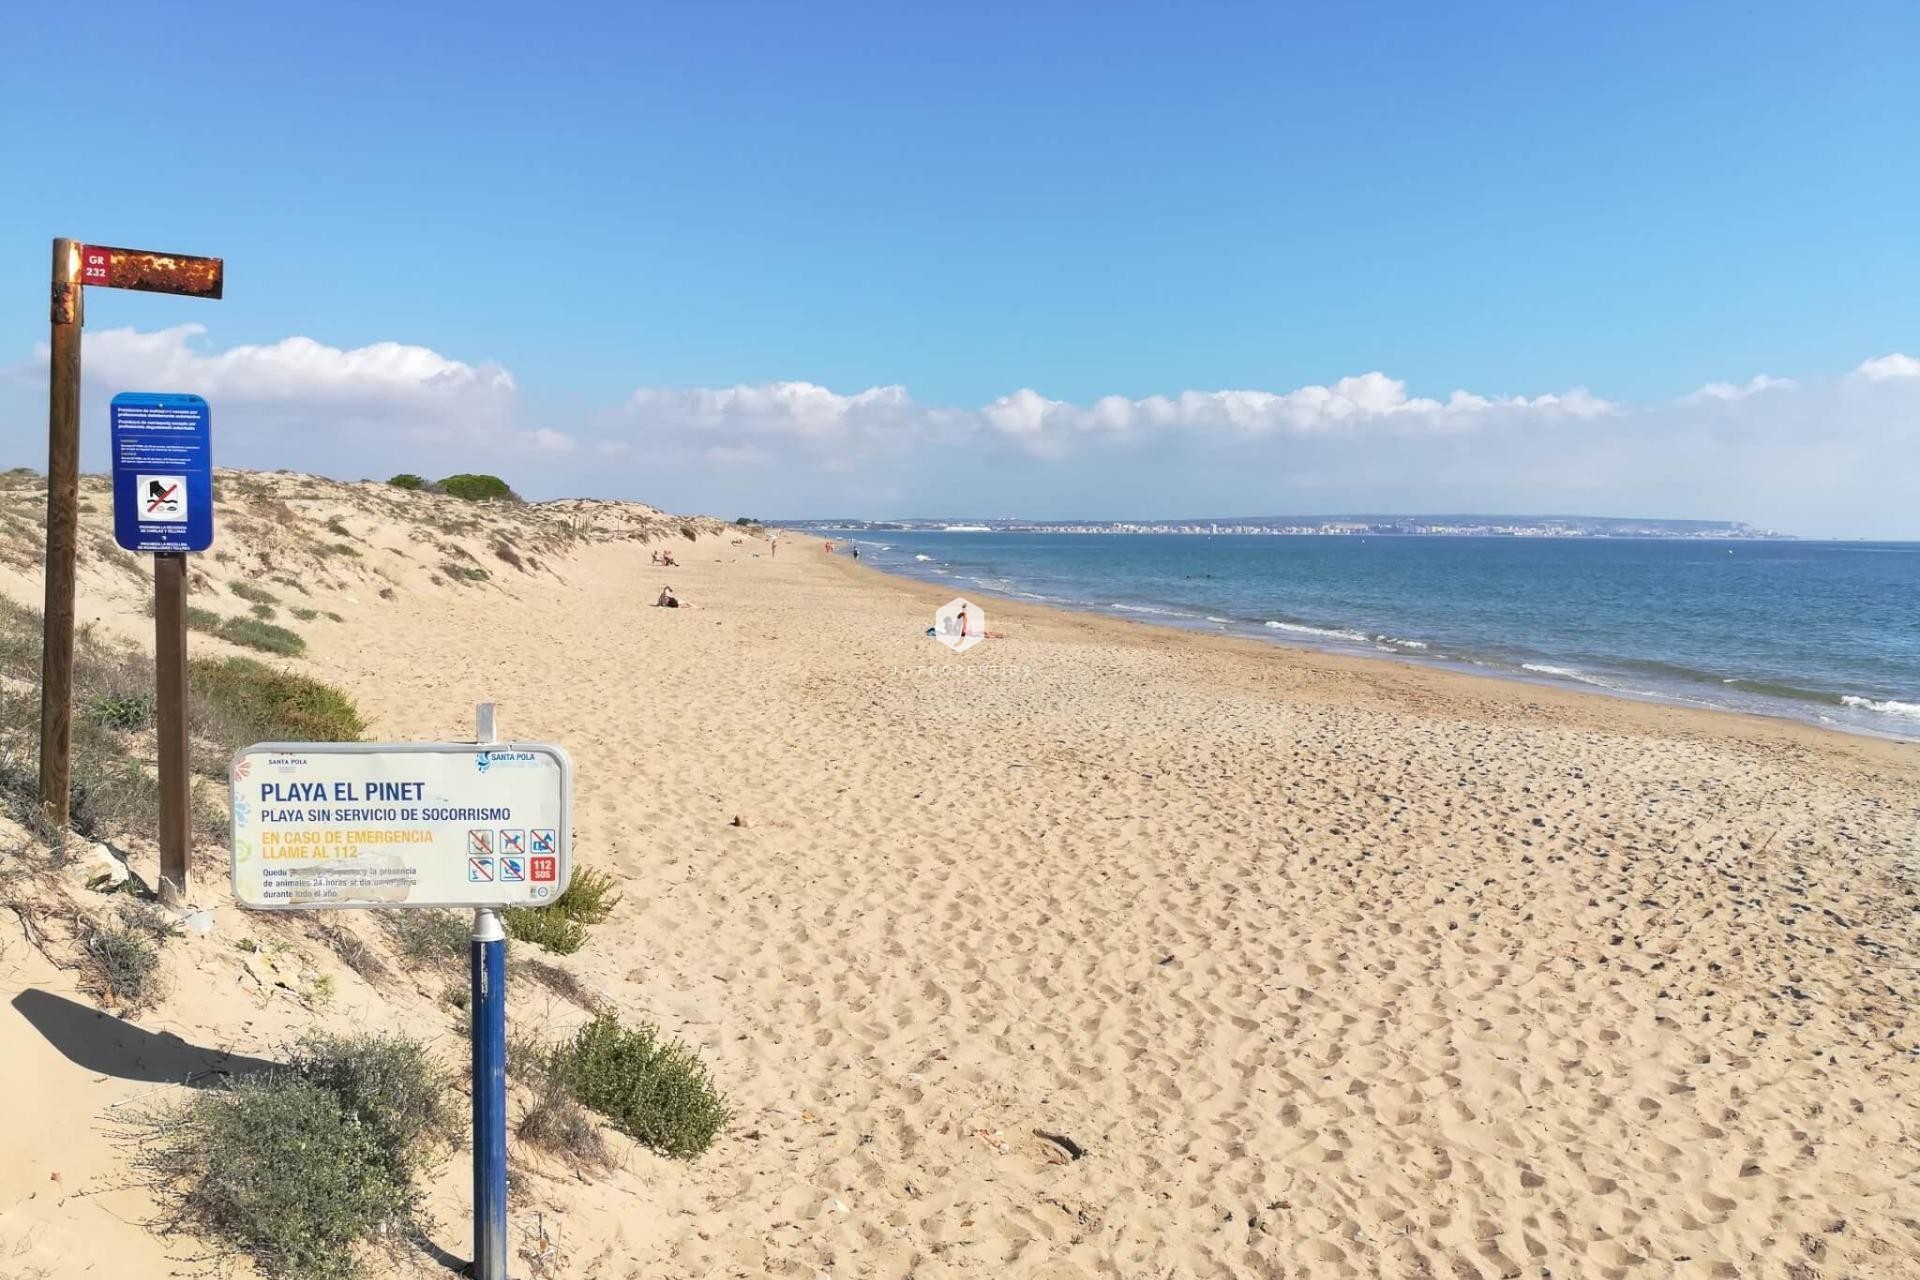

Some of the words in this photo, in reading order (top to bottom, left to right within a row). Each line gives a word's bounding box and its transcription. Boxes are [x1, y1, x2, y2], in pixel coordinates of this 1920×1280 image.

[88, 255, 104, 265] GR
[86, 267, 106, 277] 232
[491, 753, 515, 761] SANTA
[516, 753, 535, 761] POLA
[261, 783, 327, 801] PLAYA
[334, 783, 358, 801] EL
[365, 782, 425, 801] PINET
[261, 810, 304, 822] PLAYA
[308, 810, 331, 821] SIN
[335, 809, 397, 821] SERVICIO
[401, 809, 418, 820] DE
[422, 808, 511, 821] SOCORRISMO
[262, 832, 281, 844] EN
[284, 831, 320, 844] CASO
[325, 831, 343, 843] DE
[347, 830, 434, 843] EMERGENCIA
[262, 847, 309, 859] LLAME
[313, 846, 330, 859] AL
[335, 845, 357, 858] 112
[534, 860, 552, 870] 112
[535, 871, 551, 879] SOS
[275, 879, 311, 887] animales
[263, 890, 293, 898] durante
